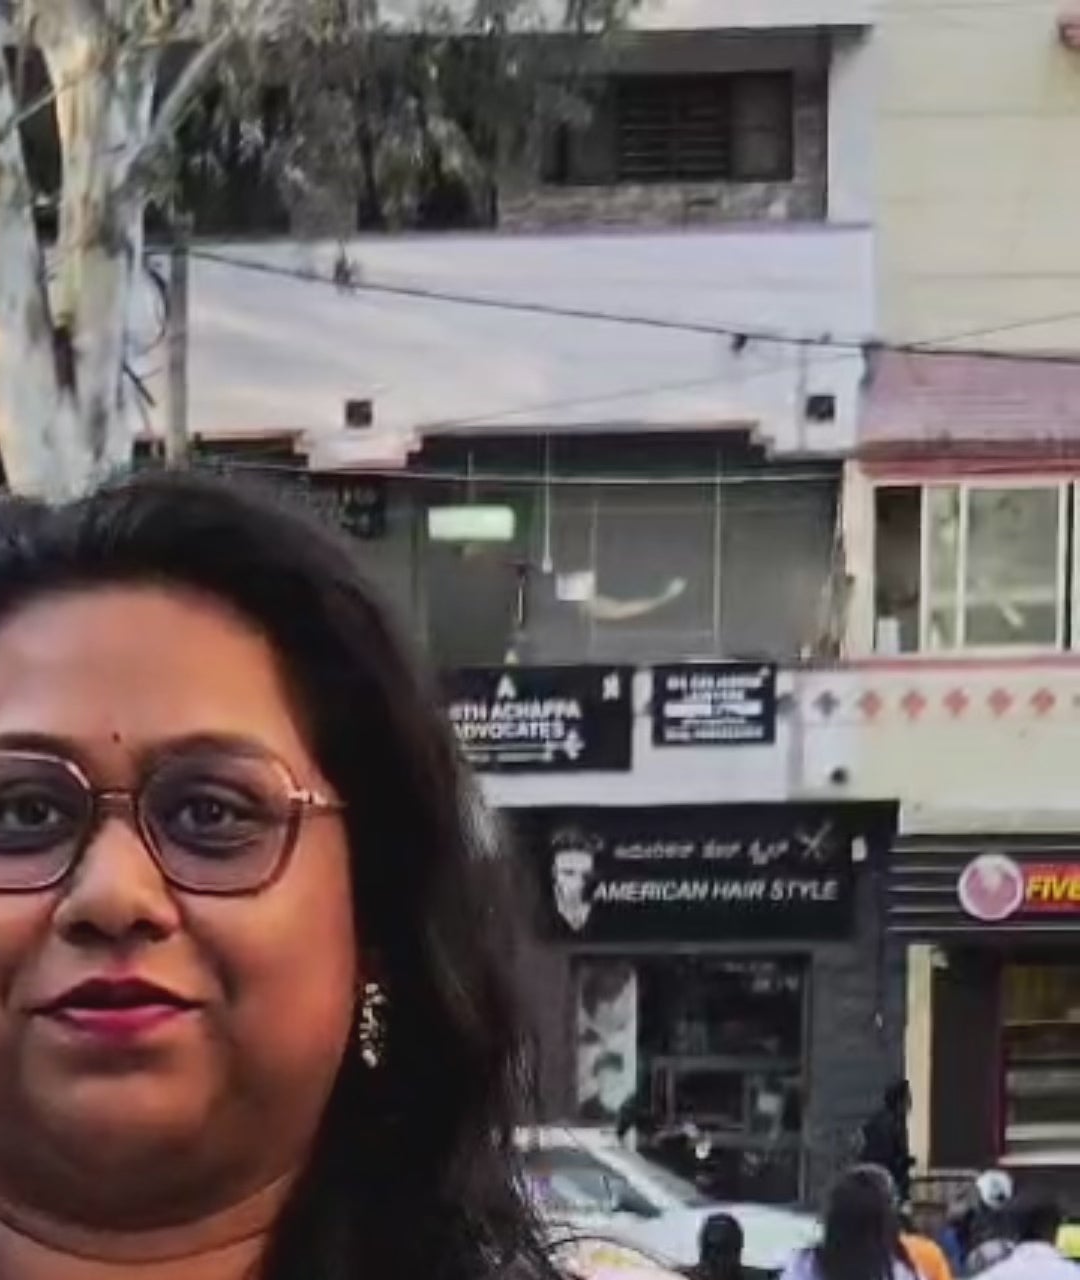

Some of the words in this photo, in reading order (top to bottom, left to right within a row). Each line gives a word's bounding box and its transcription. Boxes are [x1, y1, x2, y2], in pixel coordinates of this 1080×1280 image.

[593, 880, 709, 901] AMERICAN
[712, 880, 767, 900] HAIR
[770, 880, 839, 901] STYLE
